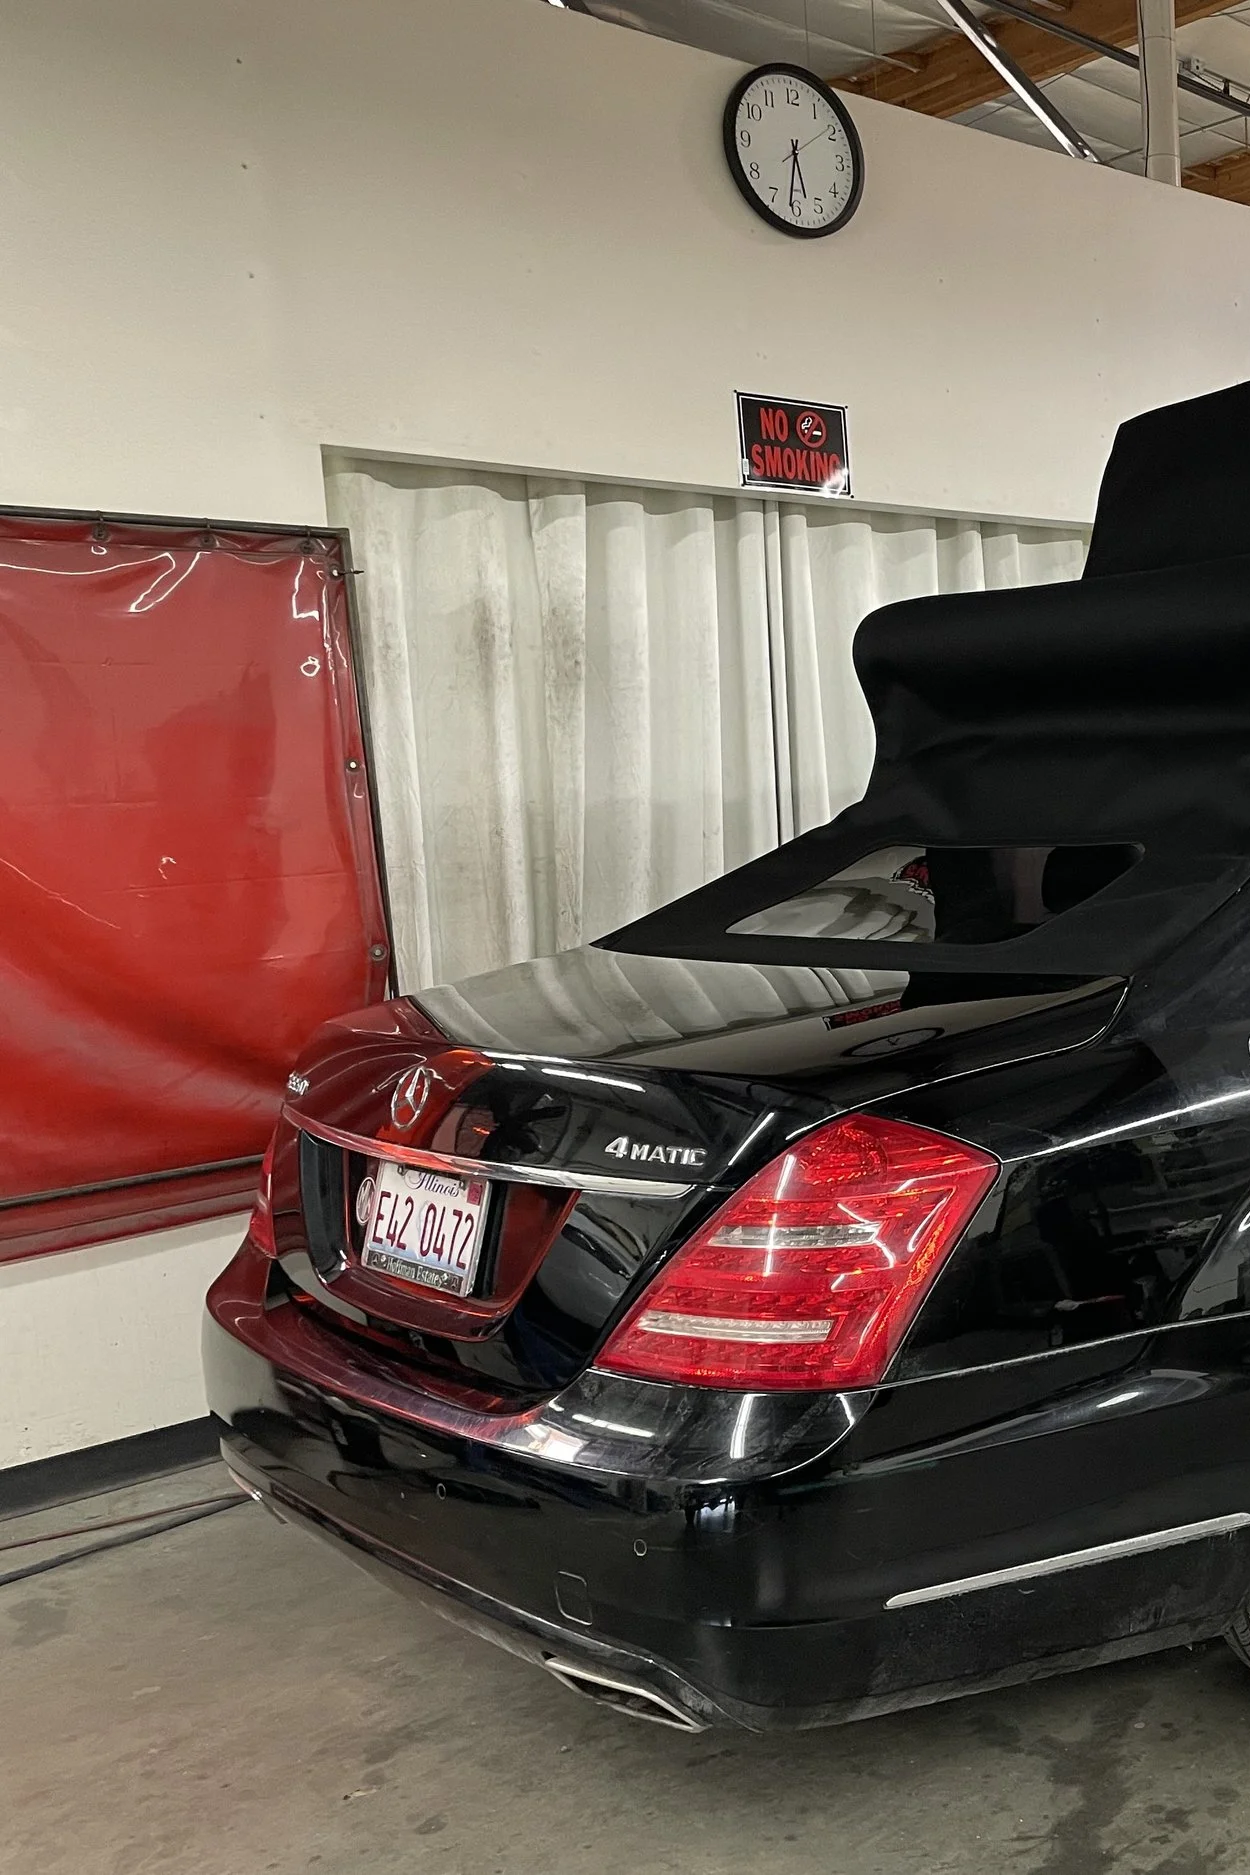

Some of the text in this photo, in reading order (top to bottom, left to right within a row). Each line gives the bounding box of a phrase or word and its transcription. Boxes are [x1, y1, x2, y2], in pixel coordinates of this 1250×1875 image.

[764, 89, 775, 108] 11
[786, 87, 800, 107] 12
[746, 102, 762, 121] 10
[812, 103, 817, 119] 1
[740, 129, 751, 148] 9
[827, 124, 836, 141] 2
[749, 161, 760, 180] 8
[835, 154, 845, 172] 3
[768, 186, 779, 203] 7
[828, 182, 840, 198] 4
[791, 200, 802, 217] 6
[813, 197, 824, 215] 5
[760, 407, 789, 442] NO
[604, 1136, 708, 1167] 4MATIC
[404, 1169, 460, 1198] Illinois
[372, 1191, 415, 1250] E42
[419, 1202, 476, 1270] 0472
[386, 1256, 416, 1280] Hoffman
